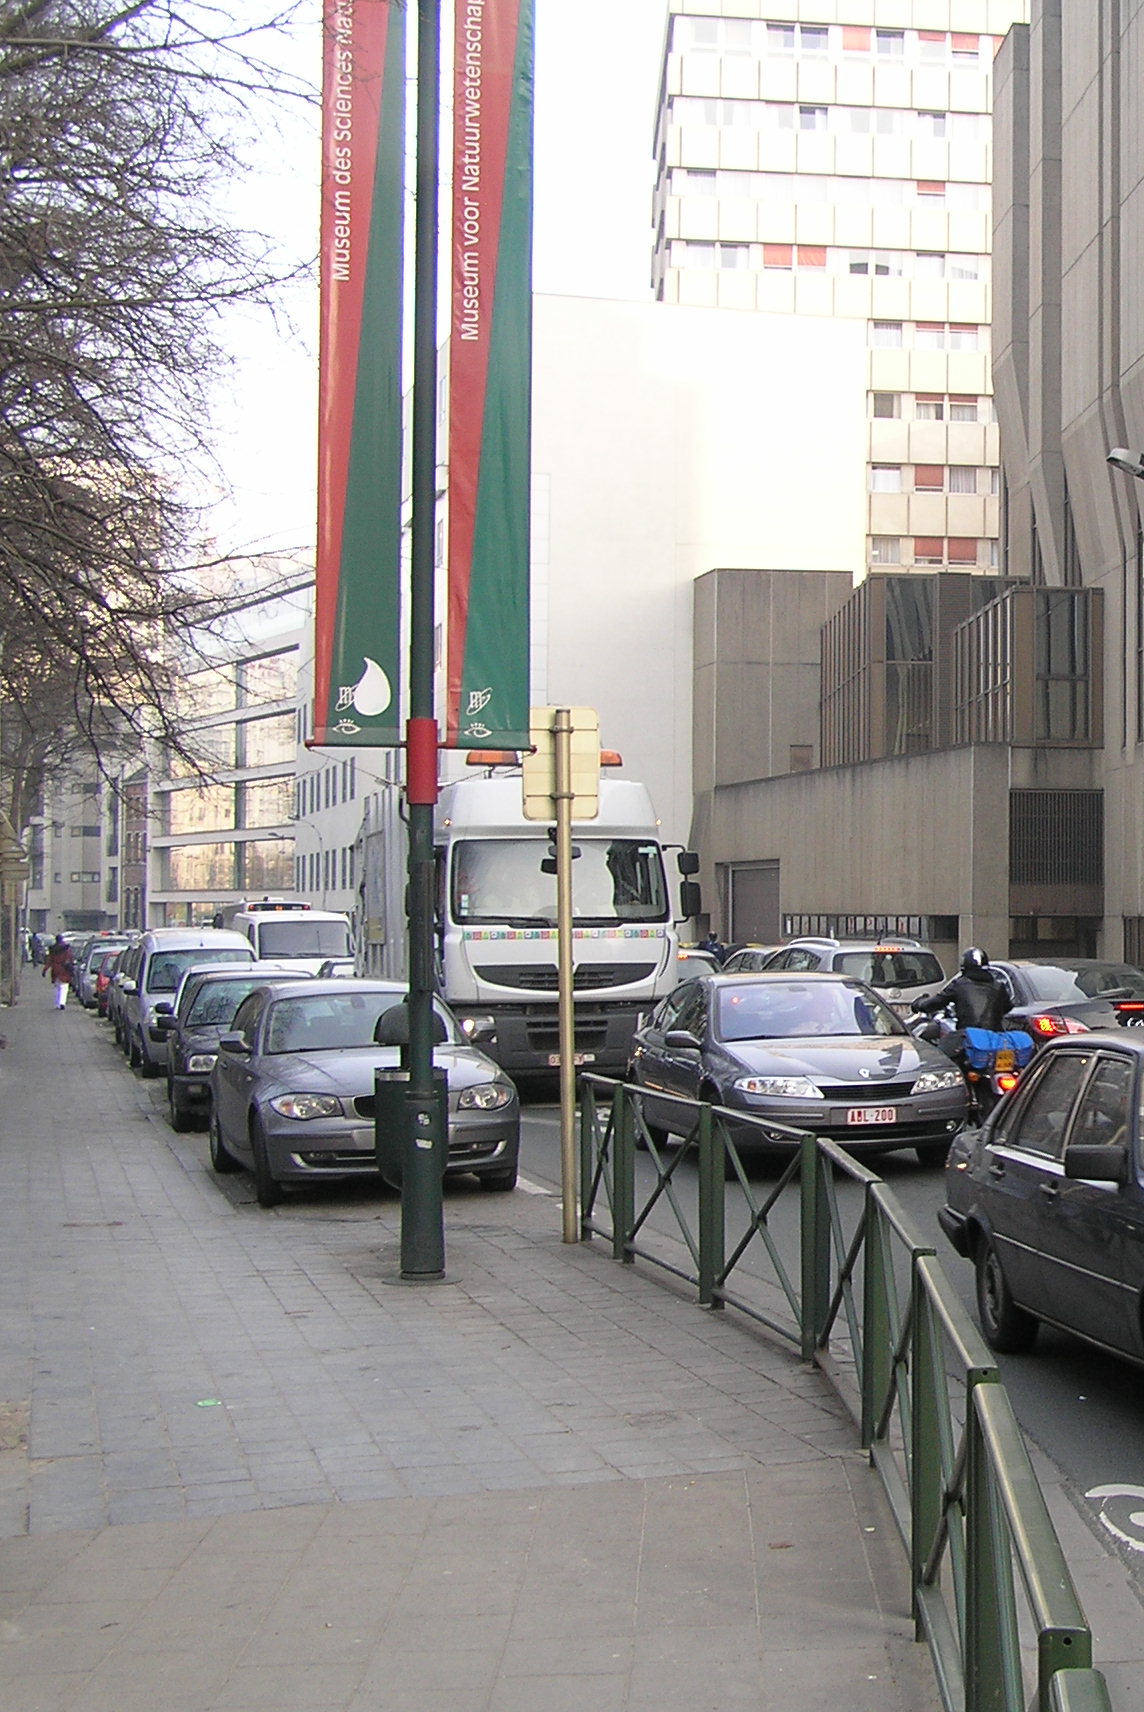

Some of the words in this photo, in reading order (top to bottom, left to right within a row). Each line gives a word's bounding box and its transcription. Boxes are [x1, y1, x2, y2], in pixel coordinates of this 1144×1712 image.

[332, 147, 351, 185] des
[332, 191, 351, 281] Museum
[464, 196, 480, 246] voor
[461, 252, 479, 341] Museum
